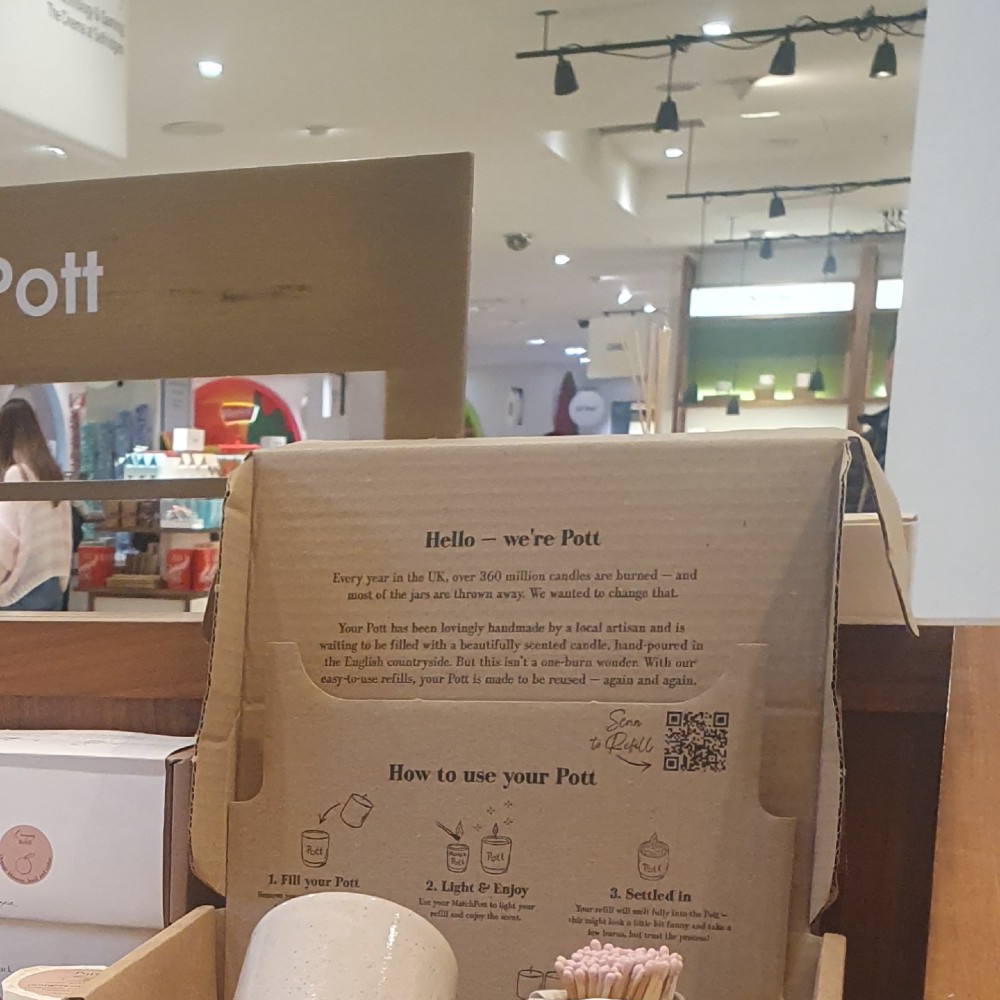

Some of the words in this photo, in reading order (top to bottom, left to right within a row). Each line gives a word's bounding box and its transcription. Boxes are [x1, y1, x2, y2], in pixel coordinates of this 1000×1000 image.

[425, 530, 475, 548] Hello
[503, 529, 555, 546] we're
[561, 529, 600, 546] Pott
[332, 572, 363, 587] Every
[365, 575, 390, 587] year
[392, 572, 404, 582] in
[407, 571, 424, 583] the
[428, 570, 449, 583] UK,
[451, 574, 476, 582] over
[479, 570, 502, 582] 360
[505, 570, 545, 581] million
[549, 569, 591, 581] candles
[594, 572, 612, 581] are
[615, 568, 658, 580] burned
[675, 568, 697, 580] and
[347, 590, 373, 600] most
[375, 588, 387, 600] of
[390, 588, 407, 599] the
[409, 588, 430, 603] jars
[433, 591, 451, 599] are
[454, 588, 493, 599] thrown
[496, 591, 525, 601] away.
[529, 587, 545, 599] We
[549, 586, 591, 598] wanted
[594, 588, 605, 598] to
[608, 586, 648, 601] change
[652, 586, 679, 598] that.
[338, 622, 363, 633] Your
[366, 622, 387, 634] Pott
[390, 622, 408, 633] has
[411, 622, 437, 633] been
[440, 621, 485, 636] lovingly
[487, 621, 545, 633] handmade
[548, 621, 563, 636] by
[575, 621, 602, 633] local
[605, 621, 646, 633] artisan
[649, 621, 671, 633] and
[675, 622, 685, 633] is
[319, 639, 358, 653] waiting
[360, 640, 371, 650] to
[374, 638, 387, 650] be
[390, 638, 419, 650] filled
[422, 638, 447, 650] with
[450, 642, 456, 650] a
[459, 638, 521, 653] beautifully
[523, 638, 567, 650] scented
[570, 638, 610, 651] candle,
[614, 638, 688, 654] hand-poured
[691, 639, 703, 650] in
[323, 656, 341, 667] the
[344, 655, 383, 670] English
[386, 655, 452, 670] countryside.
[455, 655, 476, 667] But
[479, 655, 503, 667] this
[504, 655, 528, 667] isn't
[530, 659, 538, 667] a
[540, 655, 592, 667] one-burn
[596, 656, 639, 667] wonder.
[643, 656, 671, 667] With
[675, 659, 698, 667] our
[607, 709, 642, 732] Scan
[589, 737, 601, 750] to
[605, 732, 654, 754] Refill
[388, 763, 431, 782] How
[437, 767, 457, 783] to
[463, 770, 496, 783] use
[502, 771, 549, 788] your
[555, 767, 597, 785] Pott
[306, 845, 324, 856] Pott
[268, 873, 277, 884] 1.
[280, 874, 300, 885] Fill
[304, 878, 332, 889] your
[335, 876, 360, 888] Pott
[425, 880, 437, 891] 2.
[441, 880, 474, 896] Light
[477, 882, 490, 893] &
[493, 882, 529, 899] Enjoy
[609, 887, 621, 899] 3.
[625, 887, 675, 902] Settled
[678, 890, 691, 902] in
